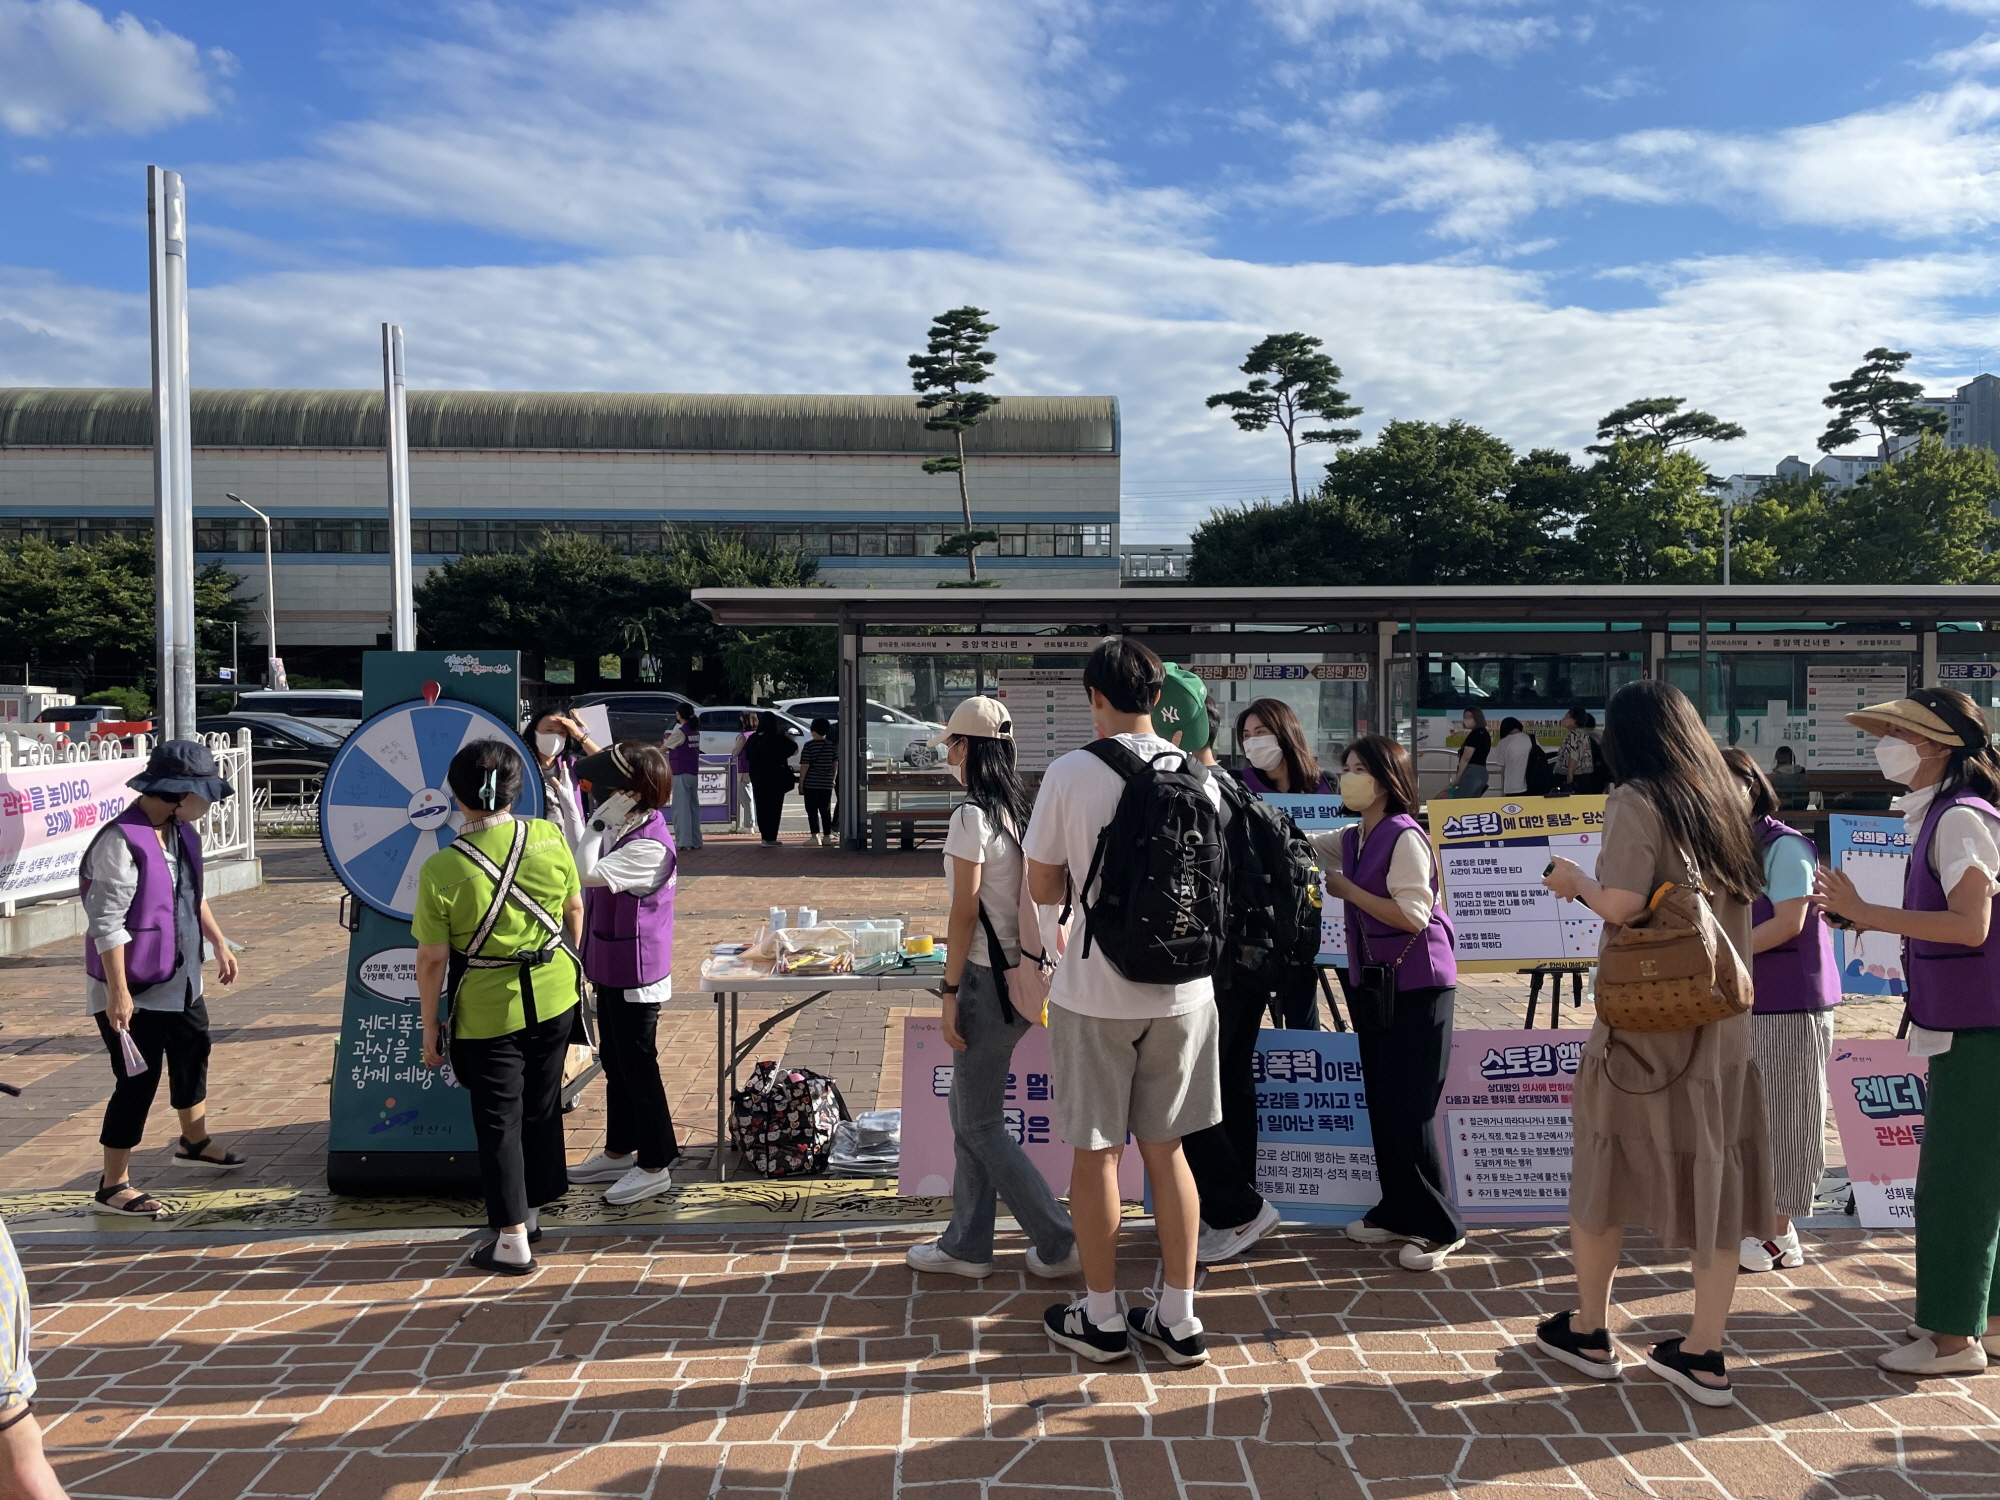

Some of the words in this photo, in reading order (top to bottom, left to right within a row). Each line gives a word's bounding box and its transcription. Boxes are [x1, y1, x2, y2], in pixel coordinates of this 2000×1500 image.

[1226, 666, 1247, 679] 세상
[1254, 665, 1282, 679] 새로운
[1286, 665, 1304, 679] 경기
[1316, 666, 1345, 679] 공정한
[1347, 666, 1368, 679] 세상
[1940, 664, 1968, 678] 새로운
[1972, 664, 1992, 678] 경기
[0, 786, 46, 817] 관심을
[46, 779, 92, 808] 높이GO,
[44, 809, 72, 837] 함께
[73, 803, 98, 829] 예방
[99, 796, 125, 822] 하GO
[1291, 806, 1316, 819] 통념
[1519, 814, 1544, 829] 대한
[1449, 858, 1476, 867] 스토킹은
[1477, 858, 1498, 866] 대부분
[1450, 867, 1471, 876] 시간이
[1472, 867, 1493, 875] 지나면
[1494, 867, 1508, 875] 중단
[1509, 866, 1523, 874] 된다
[1475, 891, 1482, 899] 전
[1454, 900, 1482, 908] 기다리고
[1521, 898, 1536, 906] 아직
[1458, 932, 1479, 941] 스토킹
[352, 1037, 410, 1064] 관심을
[1480, 1044, 1558, 1080] 스토킹
[351, 1065, 390, 1089] 함께
[394, 1065, 436, 1090] 예방
[1026, 1073, 1054, 1101] 멀
[1487, 1083, 1520, 1093] 상대방의
[1522, 1083, 1547, 1092] 의사에
[1303, 1092, 1351, 1109] 가지고
[1445, 1095, 1470, 1105] 다음과
[1472, 1095, 1489, 1104] 같은
[1491, 1094, 1516, 1104] 행위로
[1517, 1094, 1559, 1104] 상대방에게
[1852, 1073, 1926, 1119] 젠더
[1267, 1114, 1315, 1132] 일어난
[1317, 1114, 1355, 1132] 폭력!
[1469, 1117, 1504, 1125] 접근하거나
[1504, 1116, 1545, 1125] 따라다니거나
[412, 1125, 453, 1136] 안산시
[1504, 1132, 1519, 1140] 학교
[1519, 1132, 1527, 1140] 등
[1527, 1132, 1535, 1140] 그
[1536, 1132, 1563, 1140] 부근에서
[1280, 1150, 1312, 1163] 상대에
[1314, 1151, 1346, 1165] 행하는
[1520, 1147, 1535, 1156] 또는
[1474, 1159, 1502, 1168] 도달하게
[1503, 1159, 1518, 1167] 하는
[1518, 1158, 1532, 1167] 행위
[1350, 1169, 1372, 1181] 폭력
[1476, 1174, 1491, 1182] 주거
[1491, 1174, 1499, 1182] 등
[1500, 1173, 1515, 1182] 또는
[1515, 1173, 1523, 1181] 그
[1523, 1173, 1544, 1182] 부근에
[1298, 1183, 1320, 1196] 포함
[1478, 1189, 1493, 1198] 주거
[1493, 1189, 1501, 1197] 등
[1501, 1189, 1523, 1197] 부근에
[1523, 1188, 1538, 1197] 있는
[1884, 1187, 1915, 1201] 성희롱
